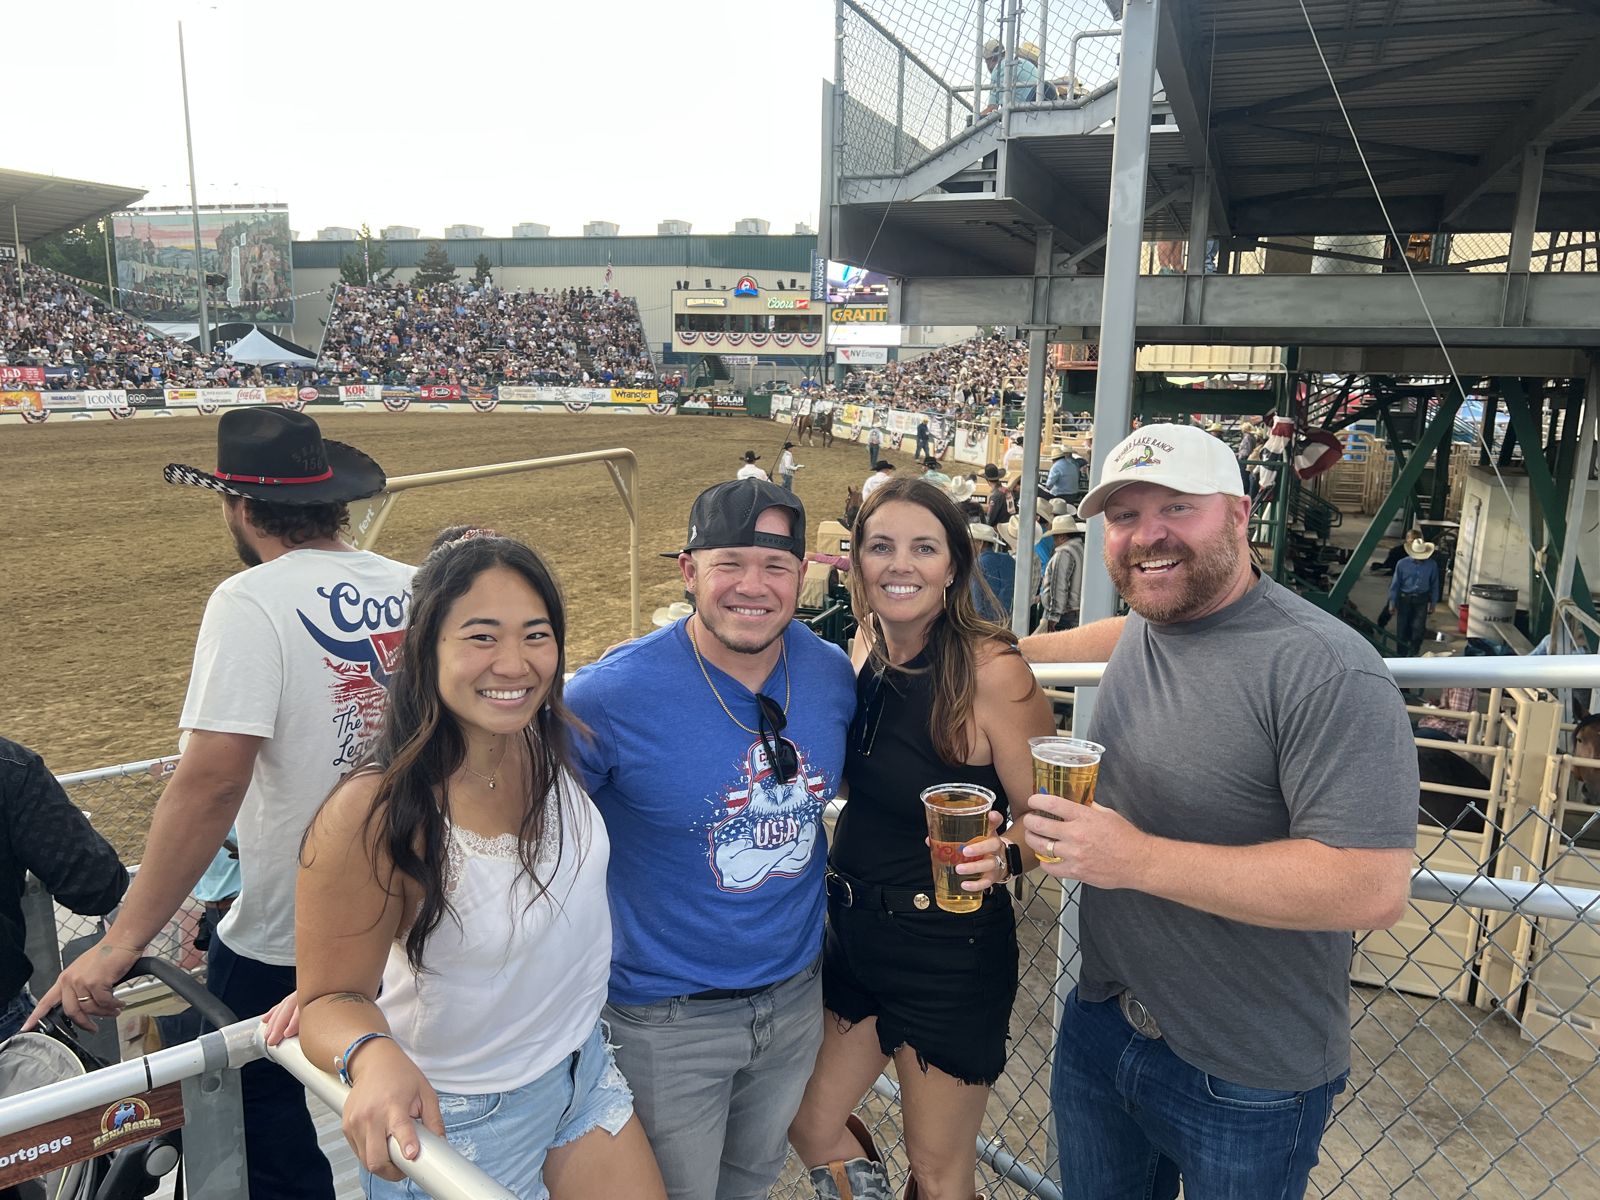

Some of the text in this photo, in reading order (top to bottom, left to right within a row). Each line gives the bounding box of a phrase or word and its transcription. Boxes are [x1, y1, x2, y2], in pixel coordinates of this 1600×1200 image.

[768, 297, 794, 309] Coors
[862, 349, 884, 359] Energy
[1, 368, 21, 378] J&D
[345, 385, 367, 395] KOH
[614, 389, 652, 402] Wrangler
[87, 392, 125, 405] ICONIC
[717, 395, 744, 403] DOLAN
[1133, 437, 1152, 446] LAKE
[1151, 438, 1175, 453] RANCH
[317, 582, 412, 633] Coo
[333, 705, 362, 738] The
[756, 816, 798, 847] USA
